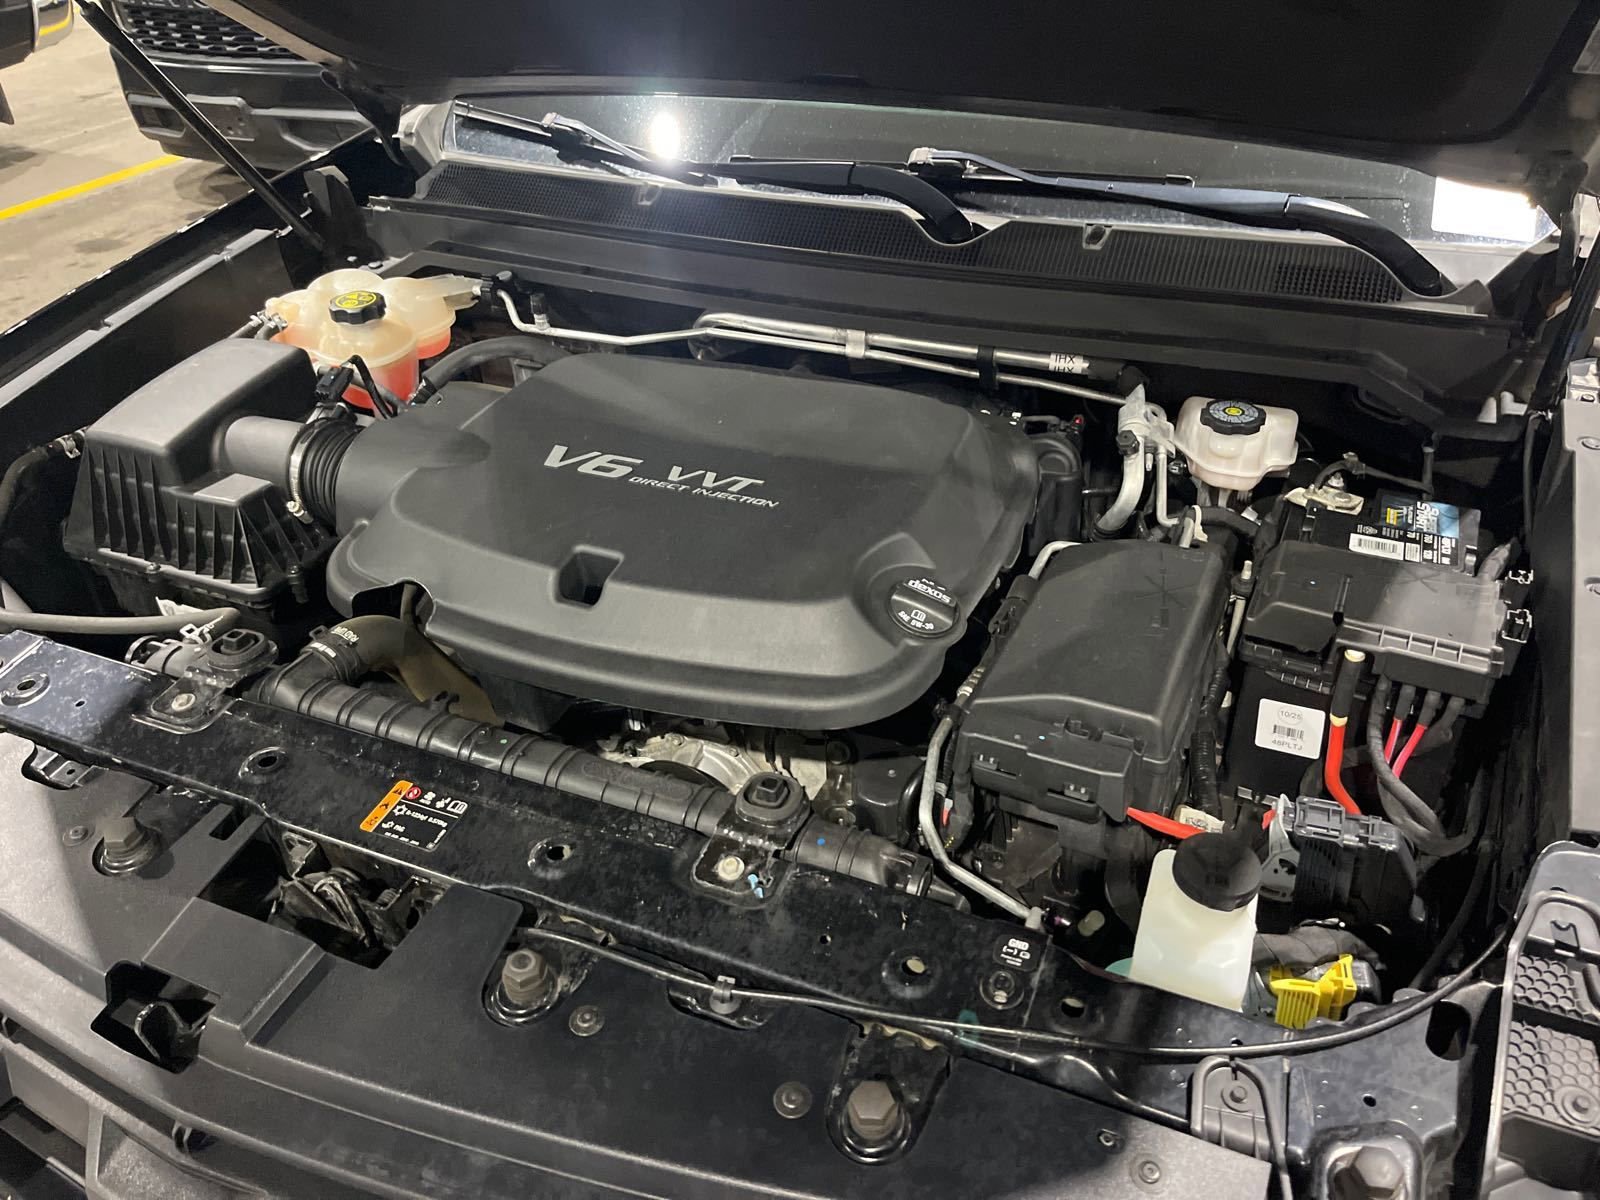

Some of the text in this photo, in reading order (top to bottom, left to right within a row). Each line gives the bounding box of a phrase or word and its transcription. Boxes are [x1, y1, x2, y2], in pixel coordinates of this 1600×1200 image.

[544, 444, 765, 492] V6 VVT
[629, 476, 779, 508] DIRECT INJECTION
[908, 579, 951, 603] dexos
